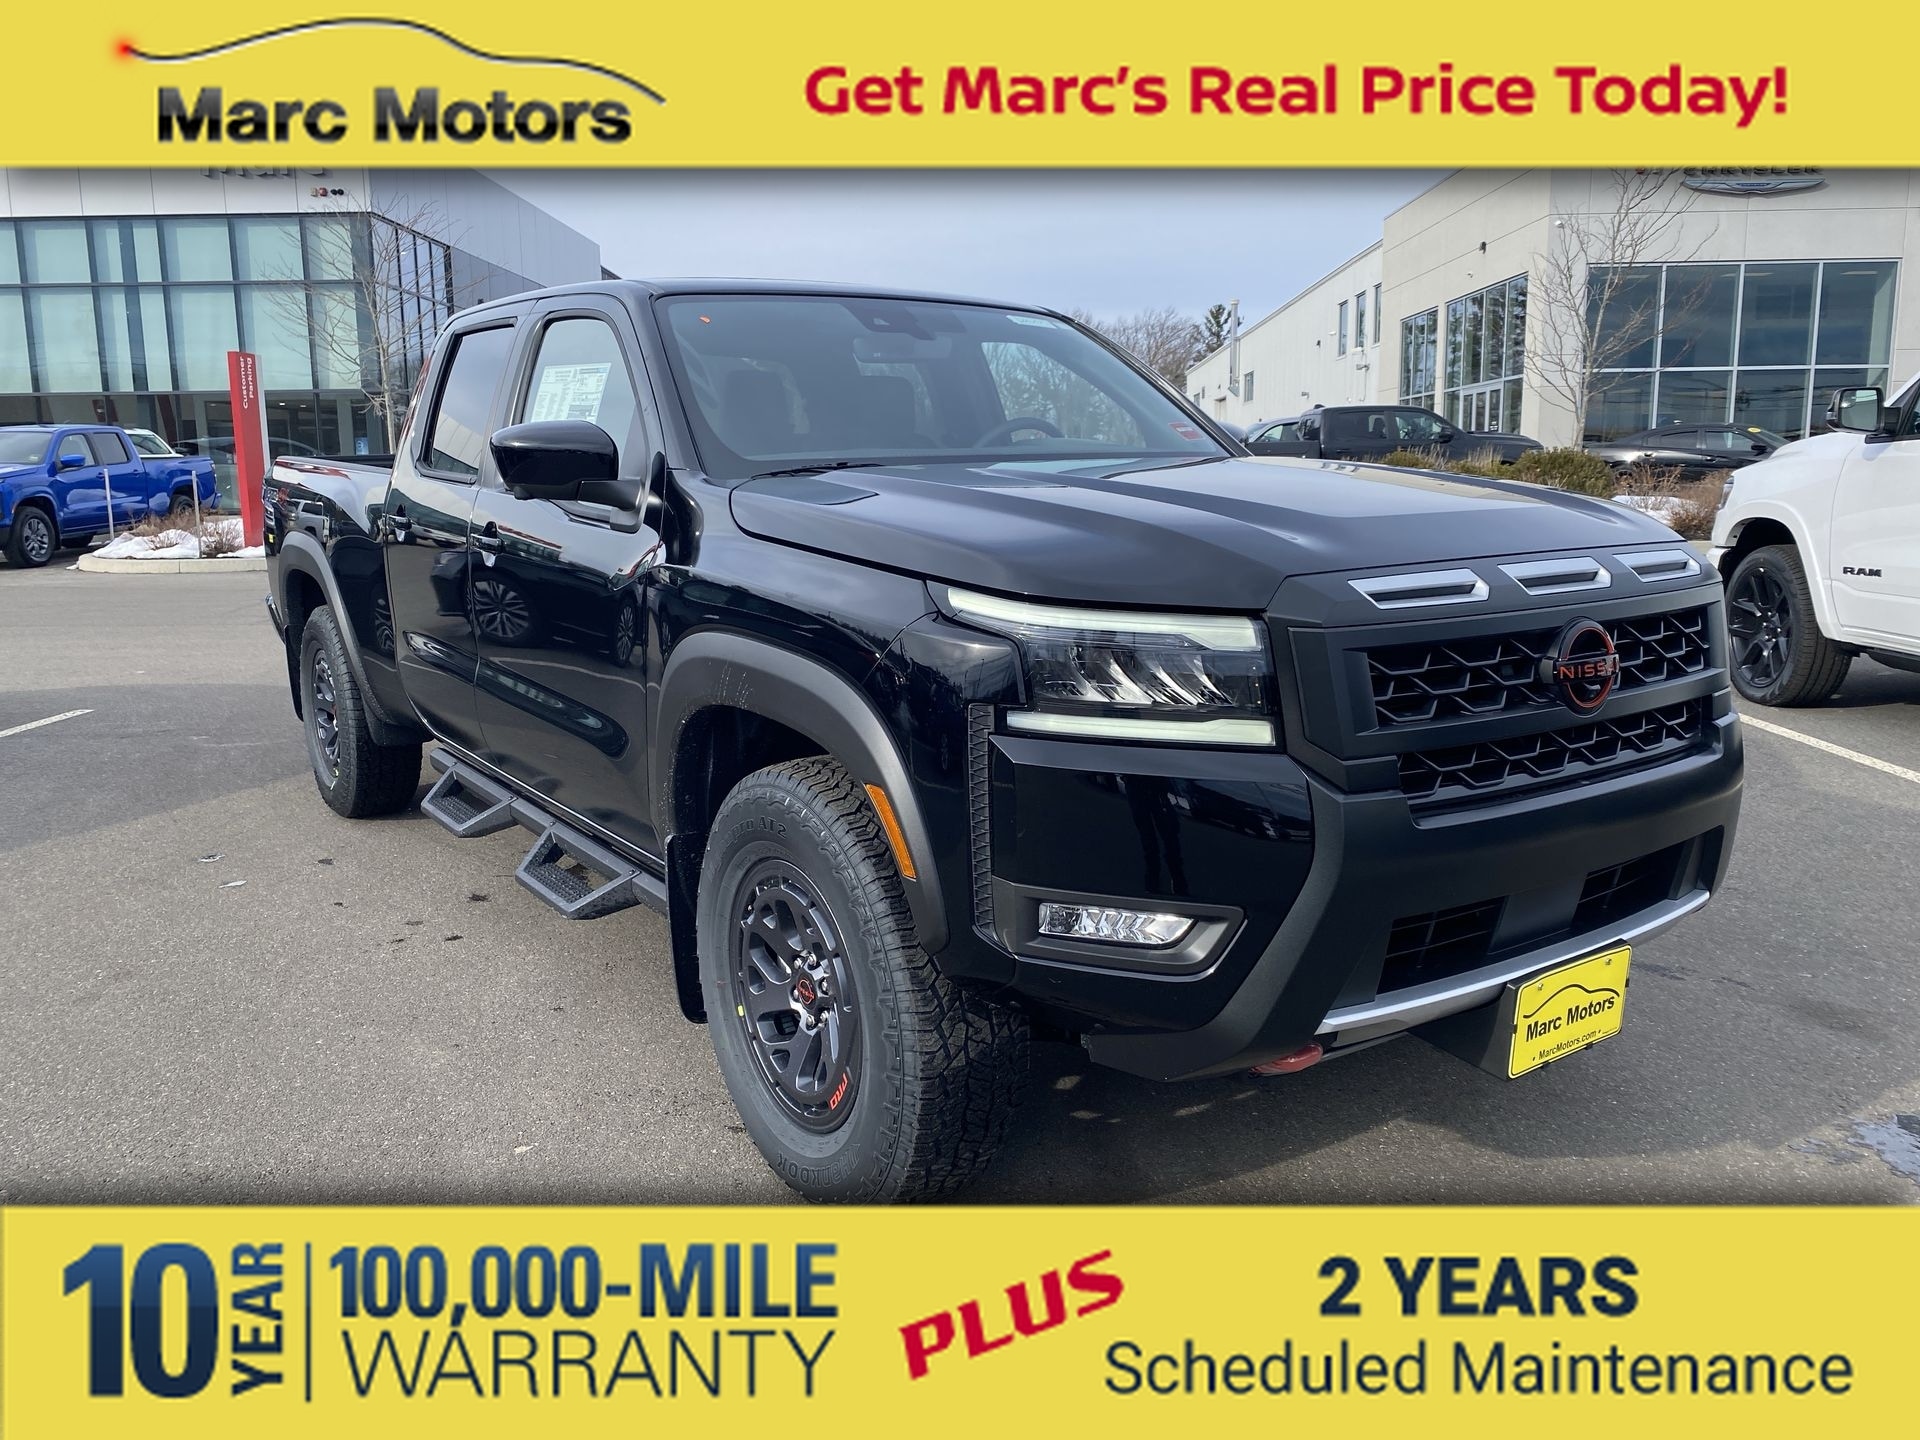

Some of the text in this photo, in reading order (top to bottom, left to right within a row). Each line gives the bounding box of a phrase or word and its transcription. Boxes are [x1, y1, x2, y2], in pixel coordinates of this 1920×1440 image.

[240, 356, 248, 409] Customer
[246, 357, 254, 399] Parking
[1843, 566, 1882, 577] RAM
[1559, 659, 1618, 679] NISS
[1526, 996, 1615, 1042] Marc Motors
[1538, 1030, 1597, 1060] MarcMotors.com
